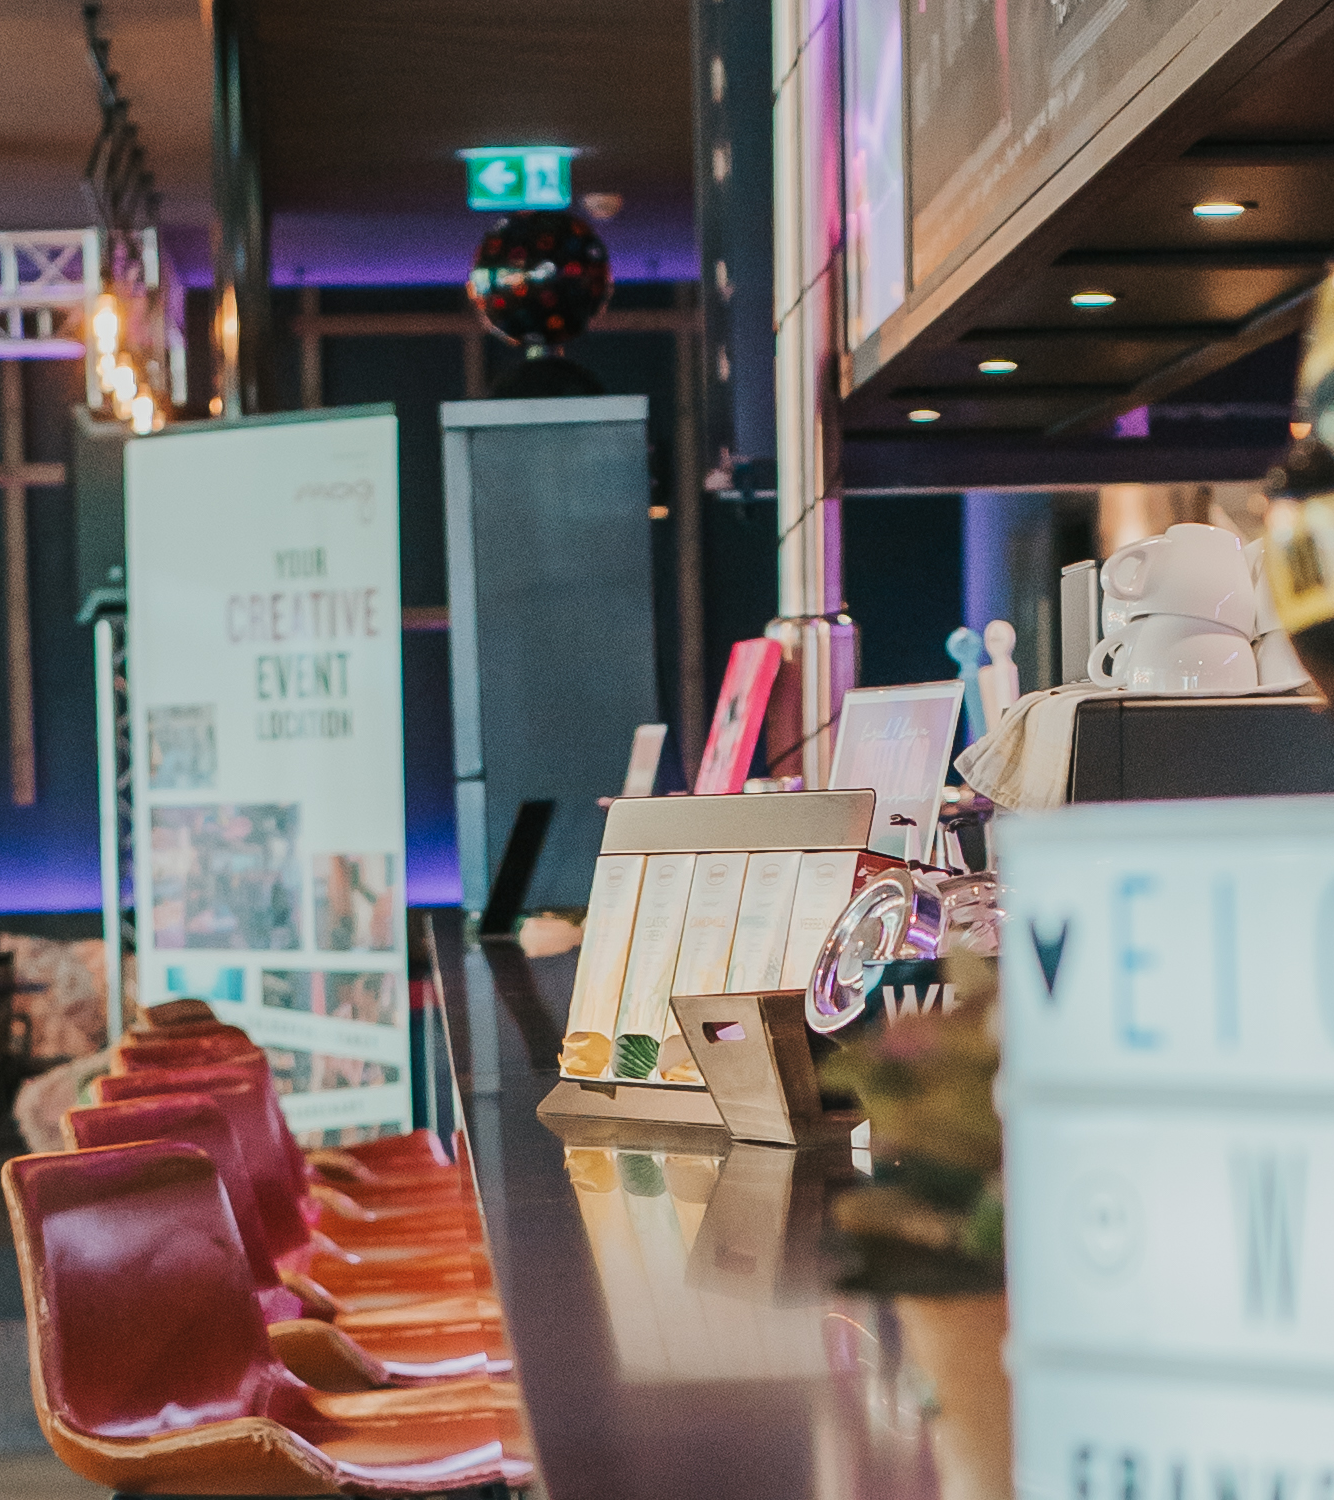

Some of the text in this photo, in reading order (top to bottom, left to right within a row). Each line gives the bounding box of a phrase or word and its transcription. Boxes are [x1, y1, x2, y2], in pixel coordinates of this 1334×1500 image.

[274, 546, 328, 579] YOUR
[224, 587, 378, 644] CREATIVE
[255, 651, 350, 701] EVENT
[255, 710, 354, 741] LOCATION
